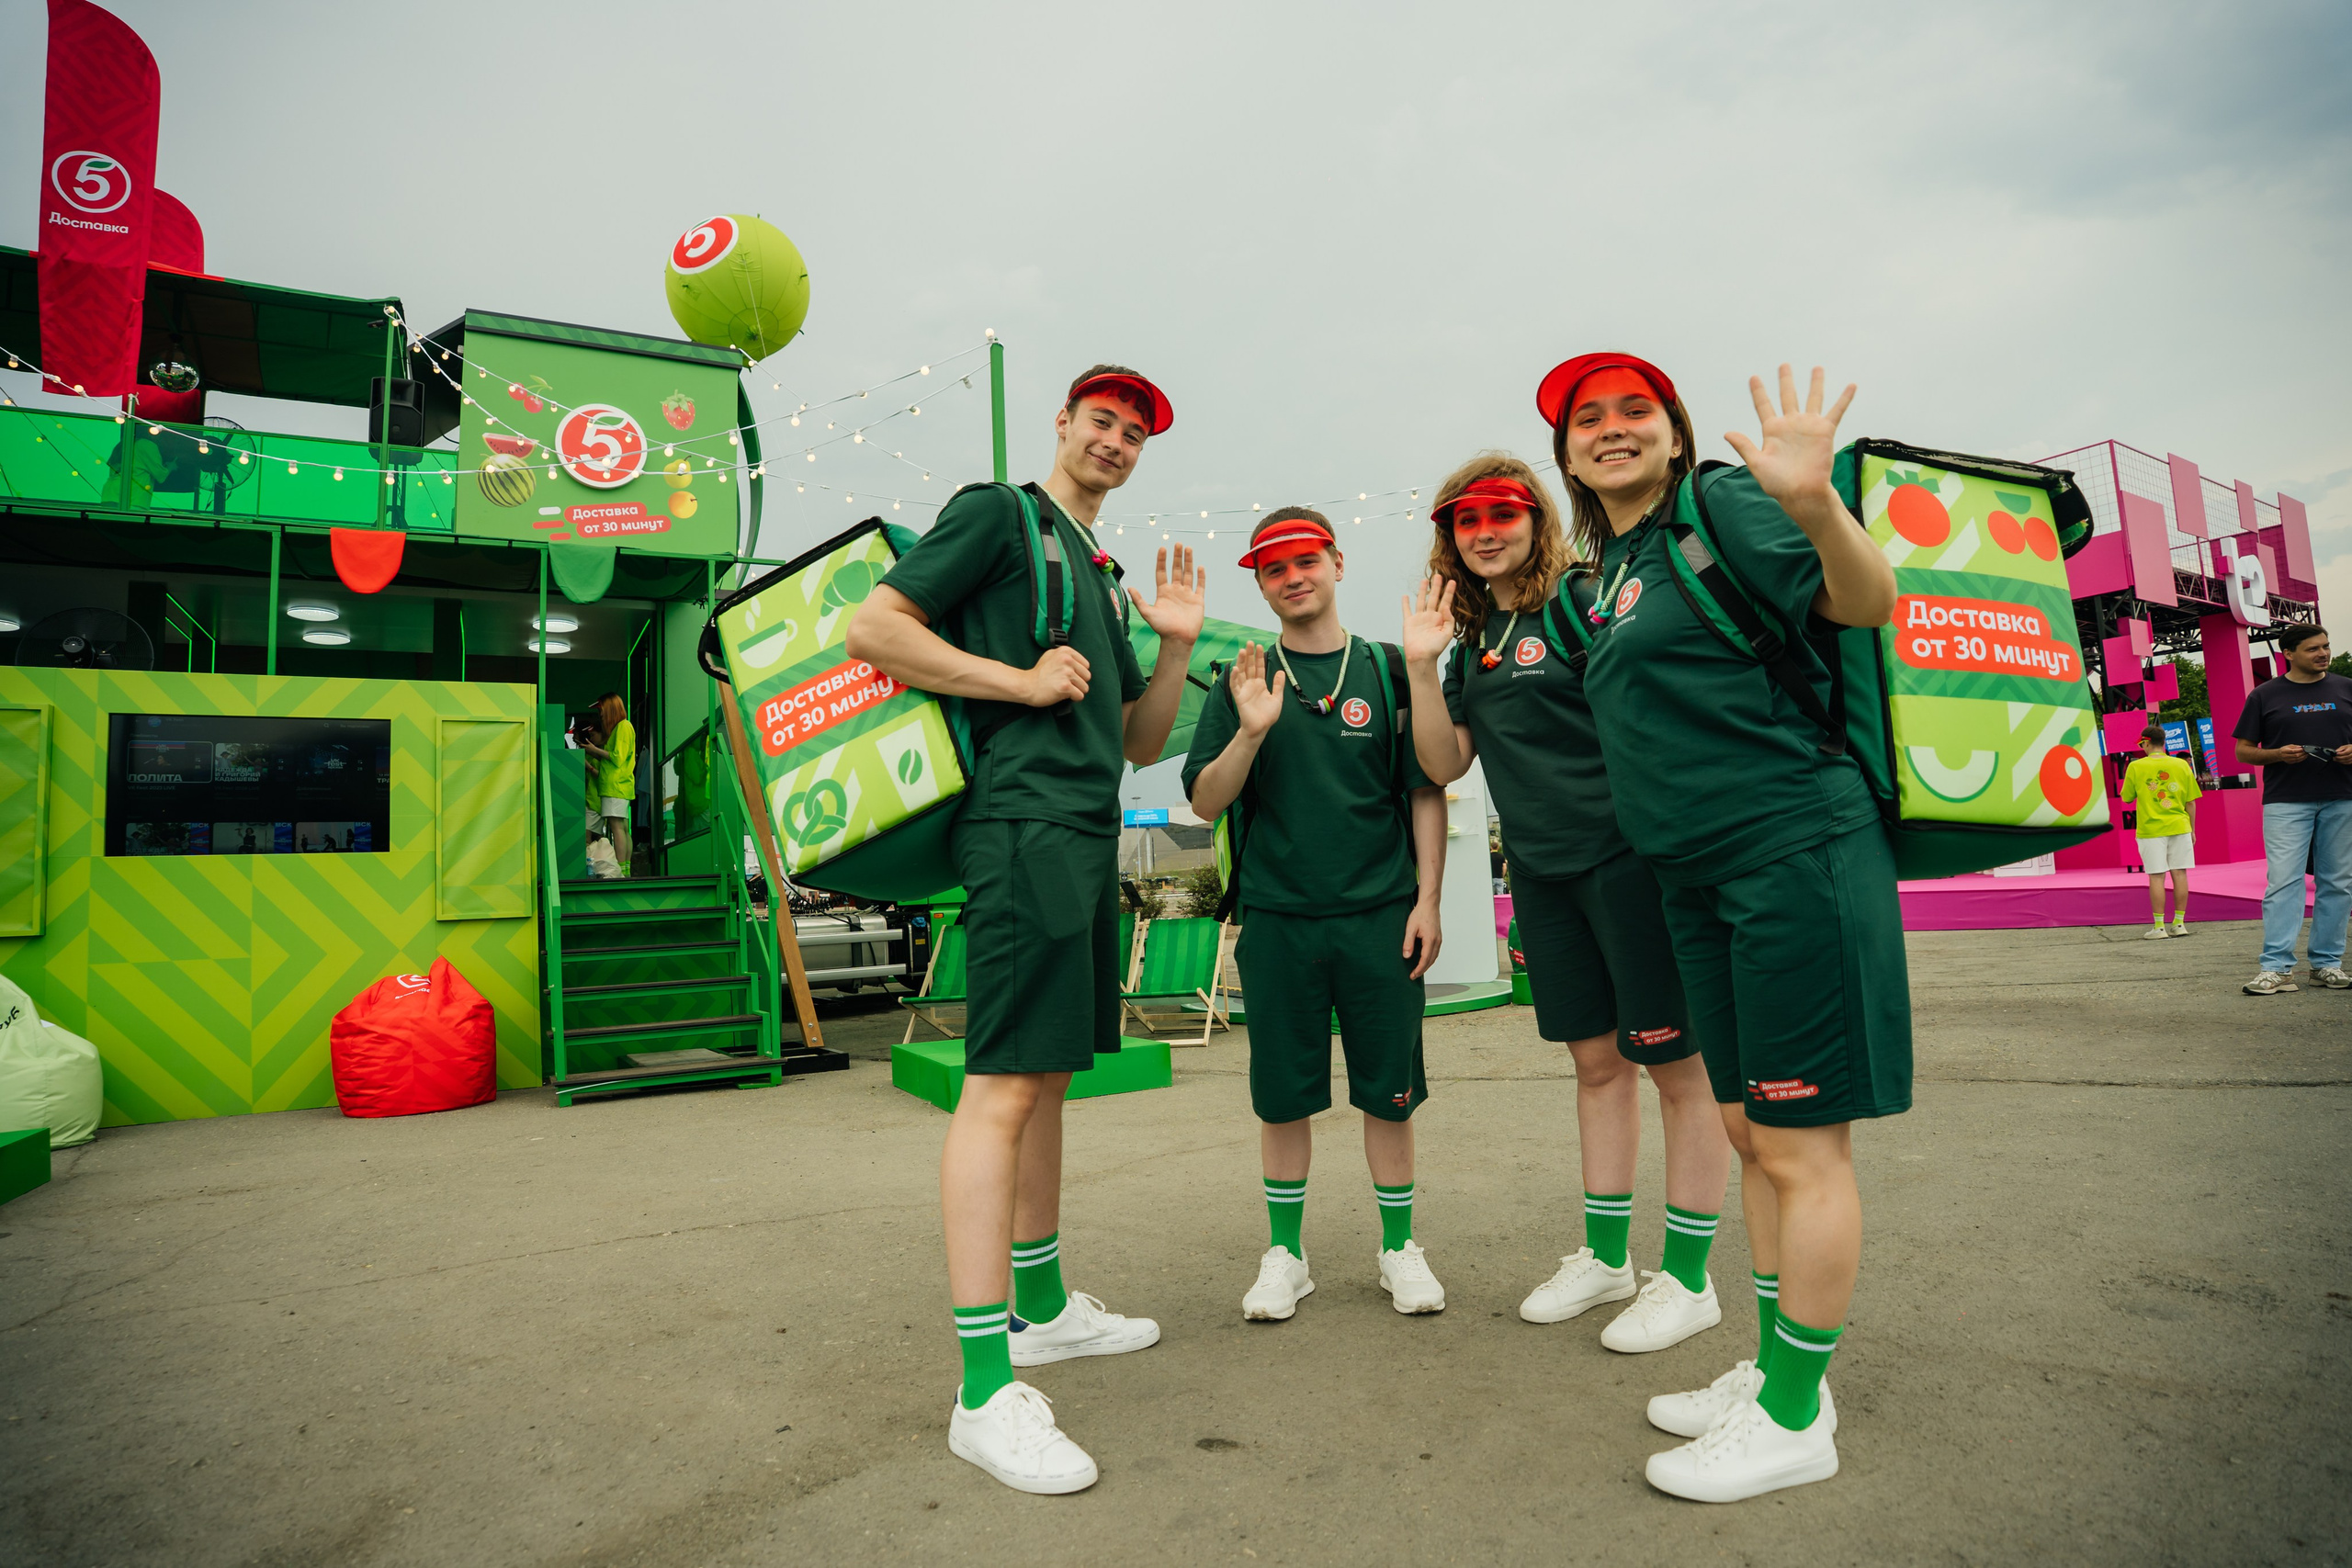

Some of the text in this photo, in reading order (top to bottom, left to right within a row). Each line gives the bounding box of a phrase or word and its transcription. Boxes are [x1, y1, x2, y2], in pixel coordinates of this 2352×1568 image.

[73, 157, 116, 201] 5
[49, 211, 129, 234] Доставка
[580, 412, 627, 471] 5
[572, 506, 639, 520] Доставка
[584, 520, 664, 534] от 30 минут
[1611, 615, 1636, 636] Доставка
[1907, 601, 2041, 636] Доставка
[1521, 639, 1539, 660] 5
[1912, 636, 2070, 676] от 30 минут
[1512, 669, 1544, 678] Доставка
[765, 662, 873, 728] Доставка
[772, 676, 904, 747] от 30 мину
[1350, 700, 1366, 722] 5
[2292, 703, 2336, 714] УРАЛ
[128, 773, 183, 782] ПОЛИТА
[1642, 1028, 1668, 1038] Доставка
[1761, 1080, 1799, 1090] Доставка
[1789, 1087, 1815, 1095] минут
